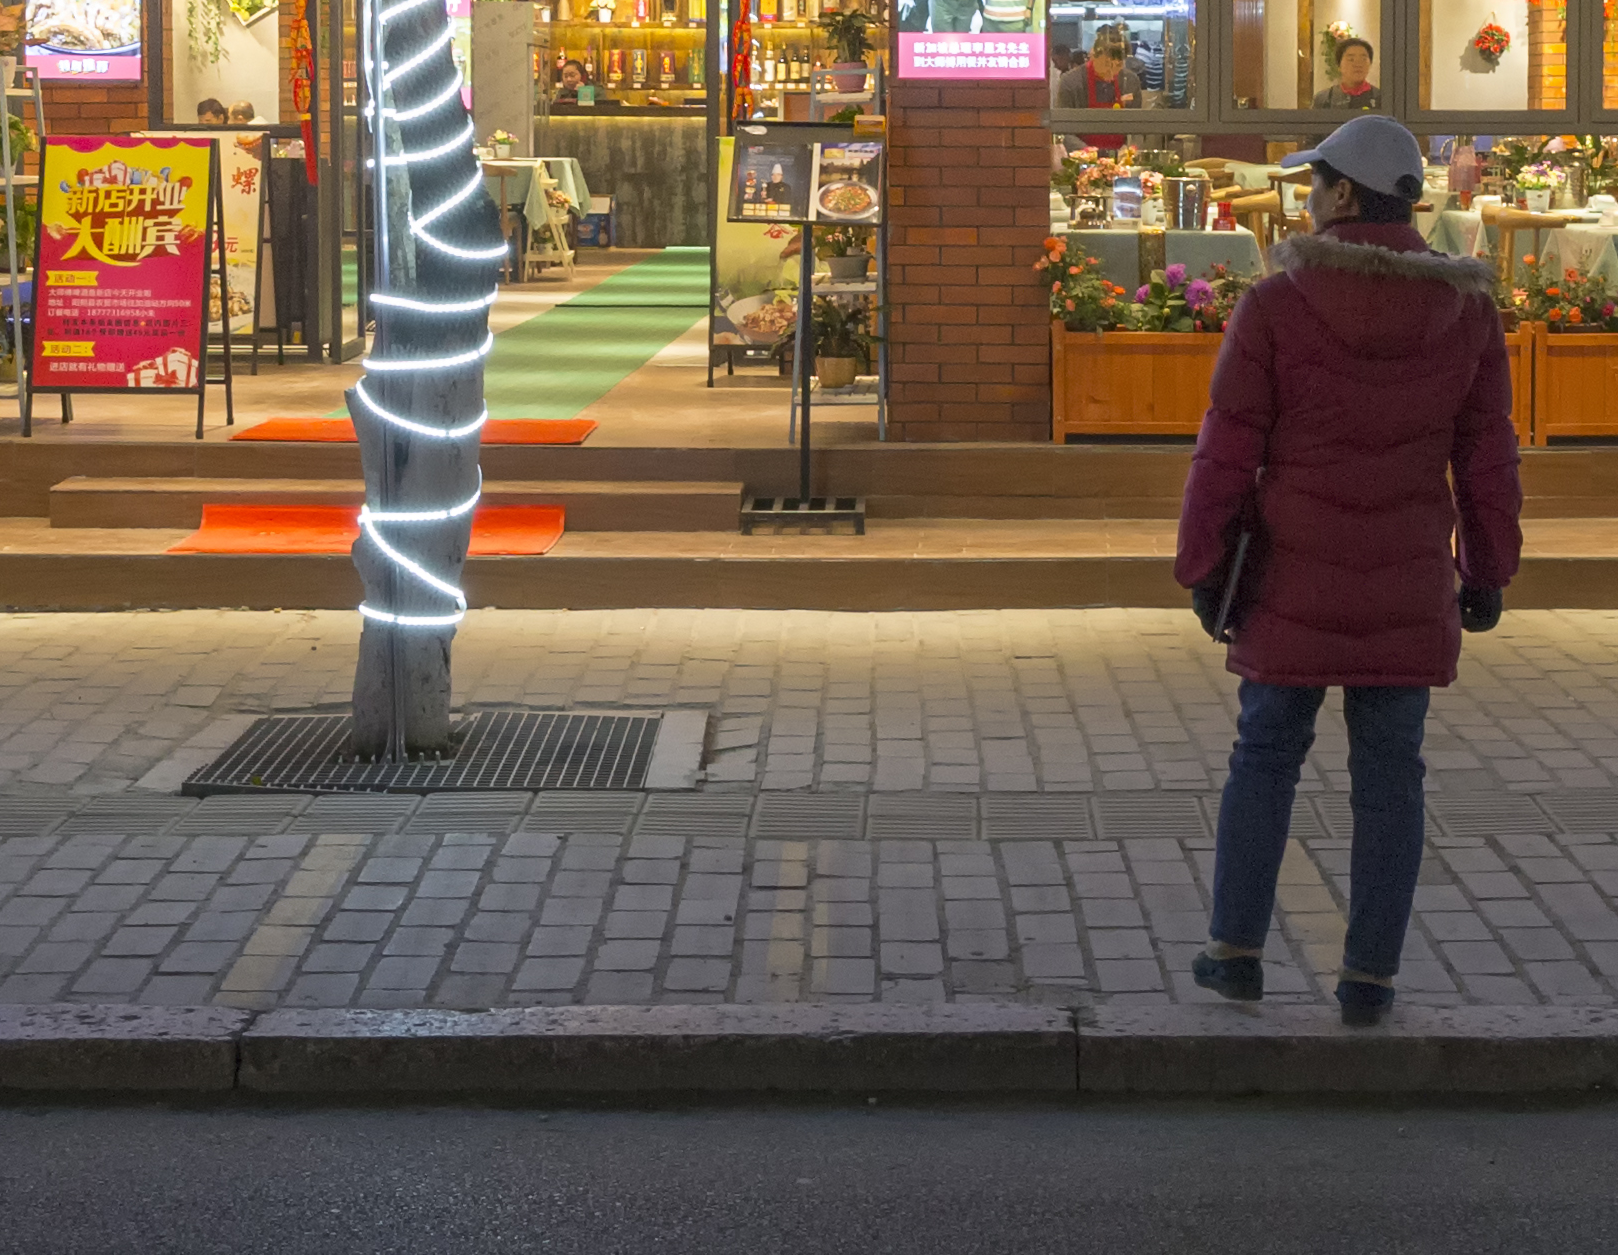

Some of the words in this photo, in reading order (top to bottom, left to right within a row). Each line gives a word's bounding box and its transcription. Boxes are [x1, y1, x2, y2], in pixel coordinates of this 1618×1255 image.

[231, 166, 259, 195] 螺
[66, 182, 187, 214] 新店开业
[60, 214, 182, 267] 大酬宾
